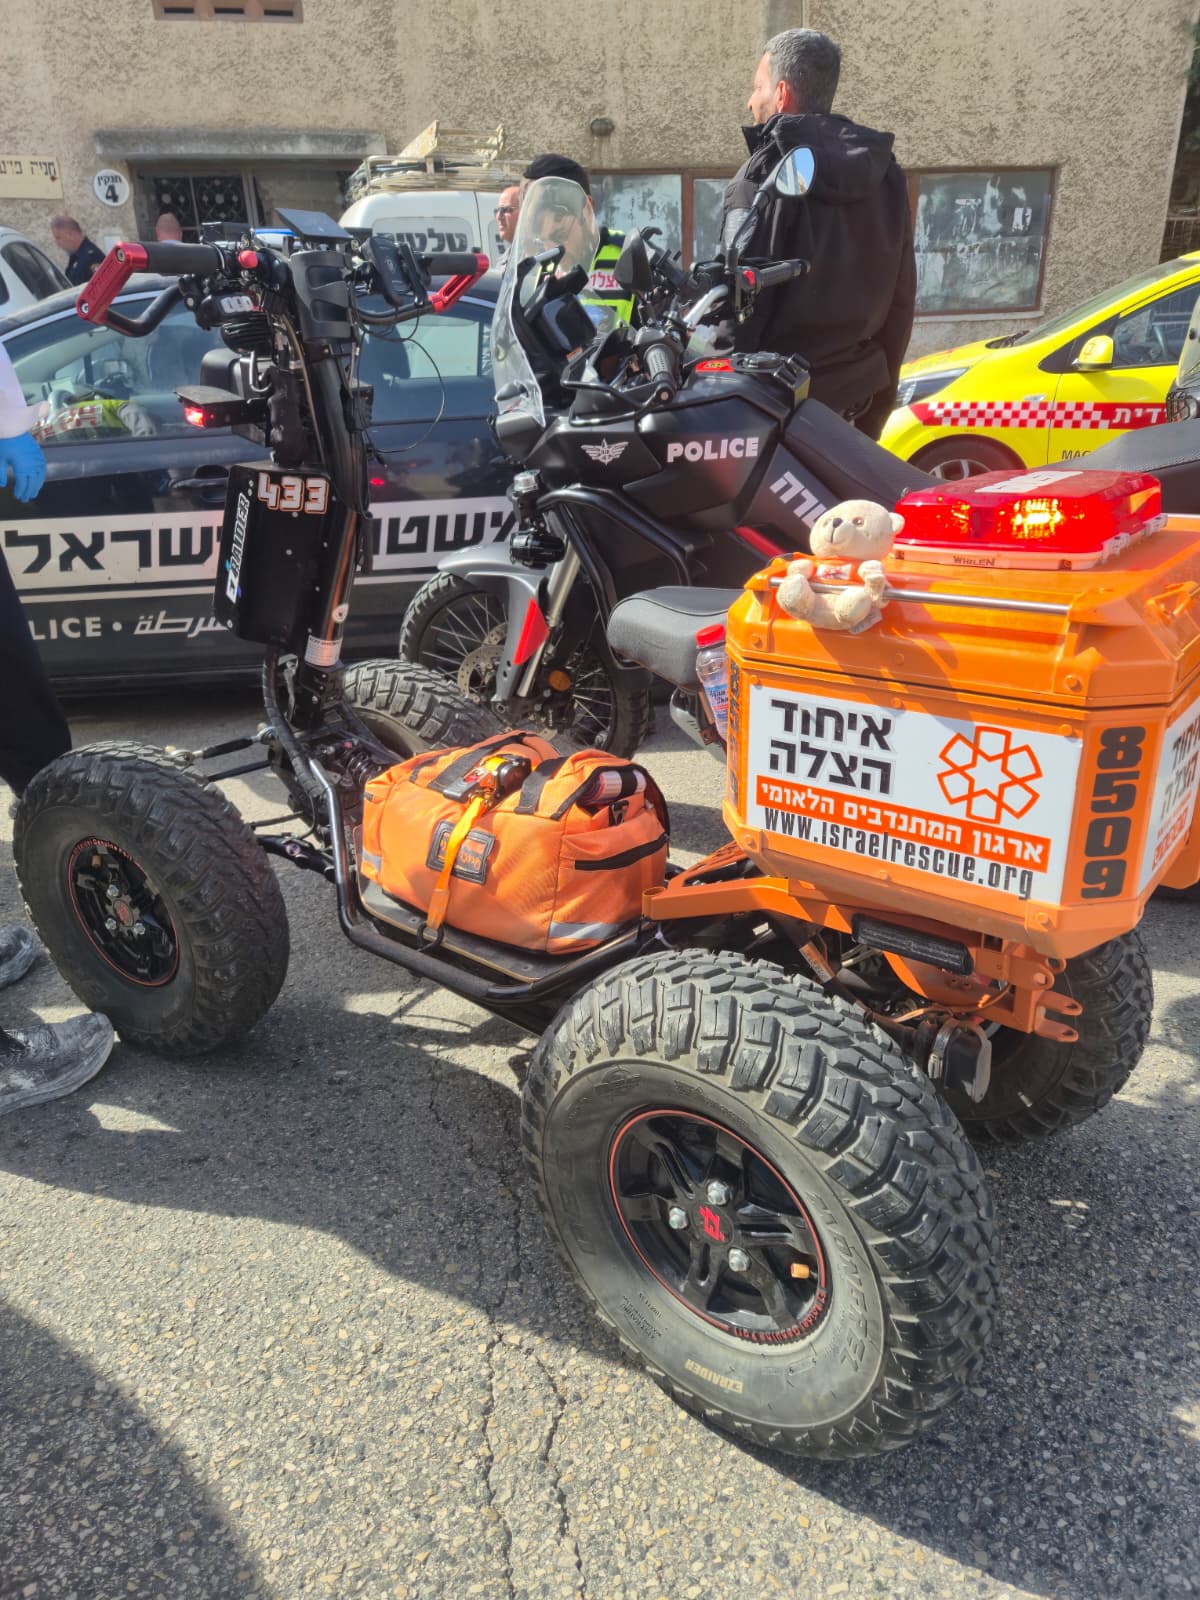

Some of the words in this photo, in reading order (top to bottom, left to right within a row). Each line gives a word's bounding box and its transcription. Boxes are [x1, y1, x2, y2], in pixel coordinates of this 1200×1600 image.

[105, 184, 119, 203] 4
[1112, 407, 1168, 425] דית
[666, 436, 760, 463] POLICE
[257, 471, 330, 515] 433
[372, 511, 519, 555] משט
[770, 699, 892, 751] איחוד
[769, 739, 892, 795] הצלה
[761, 783, 835, 815] הלאומי
[1080, 726, 1147, 899] 8509
[843, 800, 962, 845] המתנדבים
[765, 807, 1034, 900] www.israelrescue.org
[972, 830, 1044, 863] ארגון
